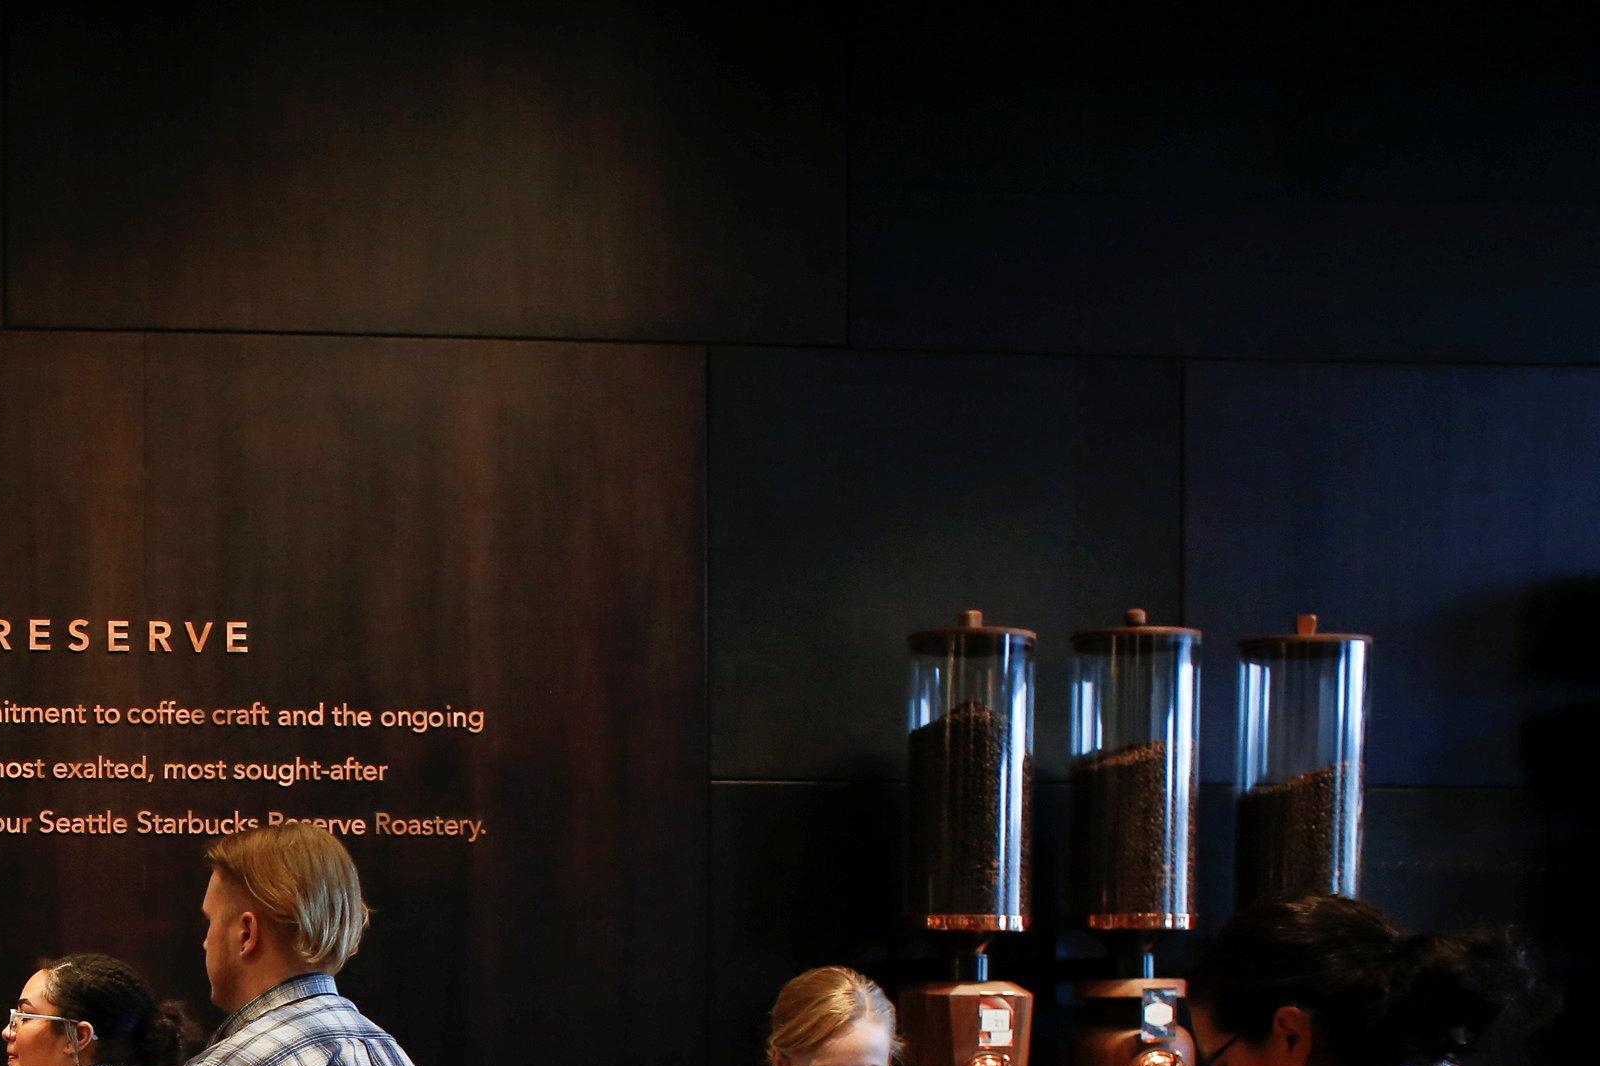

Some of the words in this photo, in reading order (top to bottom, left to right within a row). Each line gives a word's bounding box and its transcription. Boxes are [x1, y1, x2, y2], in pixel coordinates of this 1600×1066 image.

[93, 704, 121, 725] to
[126, 700, 206, 725] coffee
[211, 701, 270, 726] craft
[277, 701, 325, 726] and
[331, 702, 372, 727] the
[380, 704, 485, 733] ongoing
[52, 754, 155, 783] exalted,
[163, 759, 227, 781] most
[232, 756, 389, 787] sought-after
[39, 809, 129, 835] Seattle
[136, 809, 259, 835] Starbucks
[375, 812, 487, 843] Roastery.
